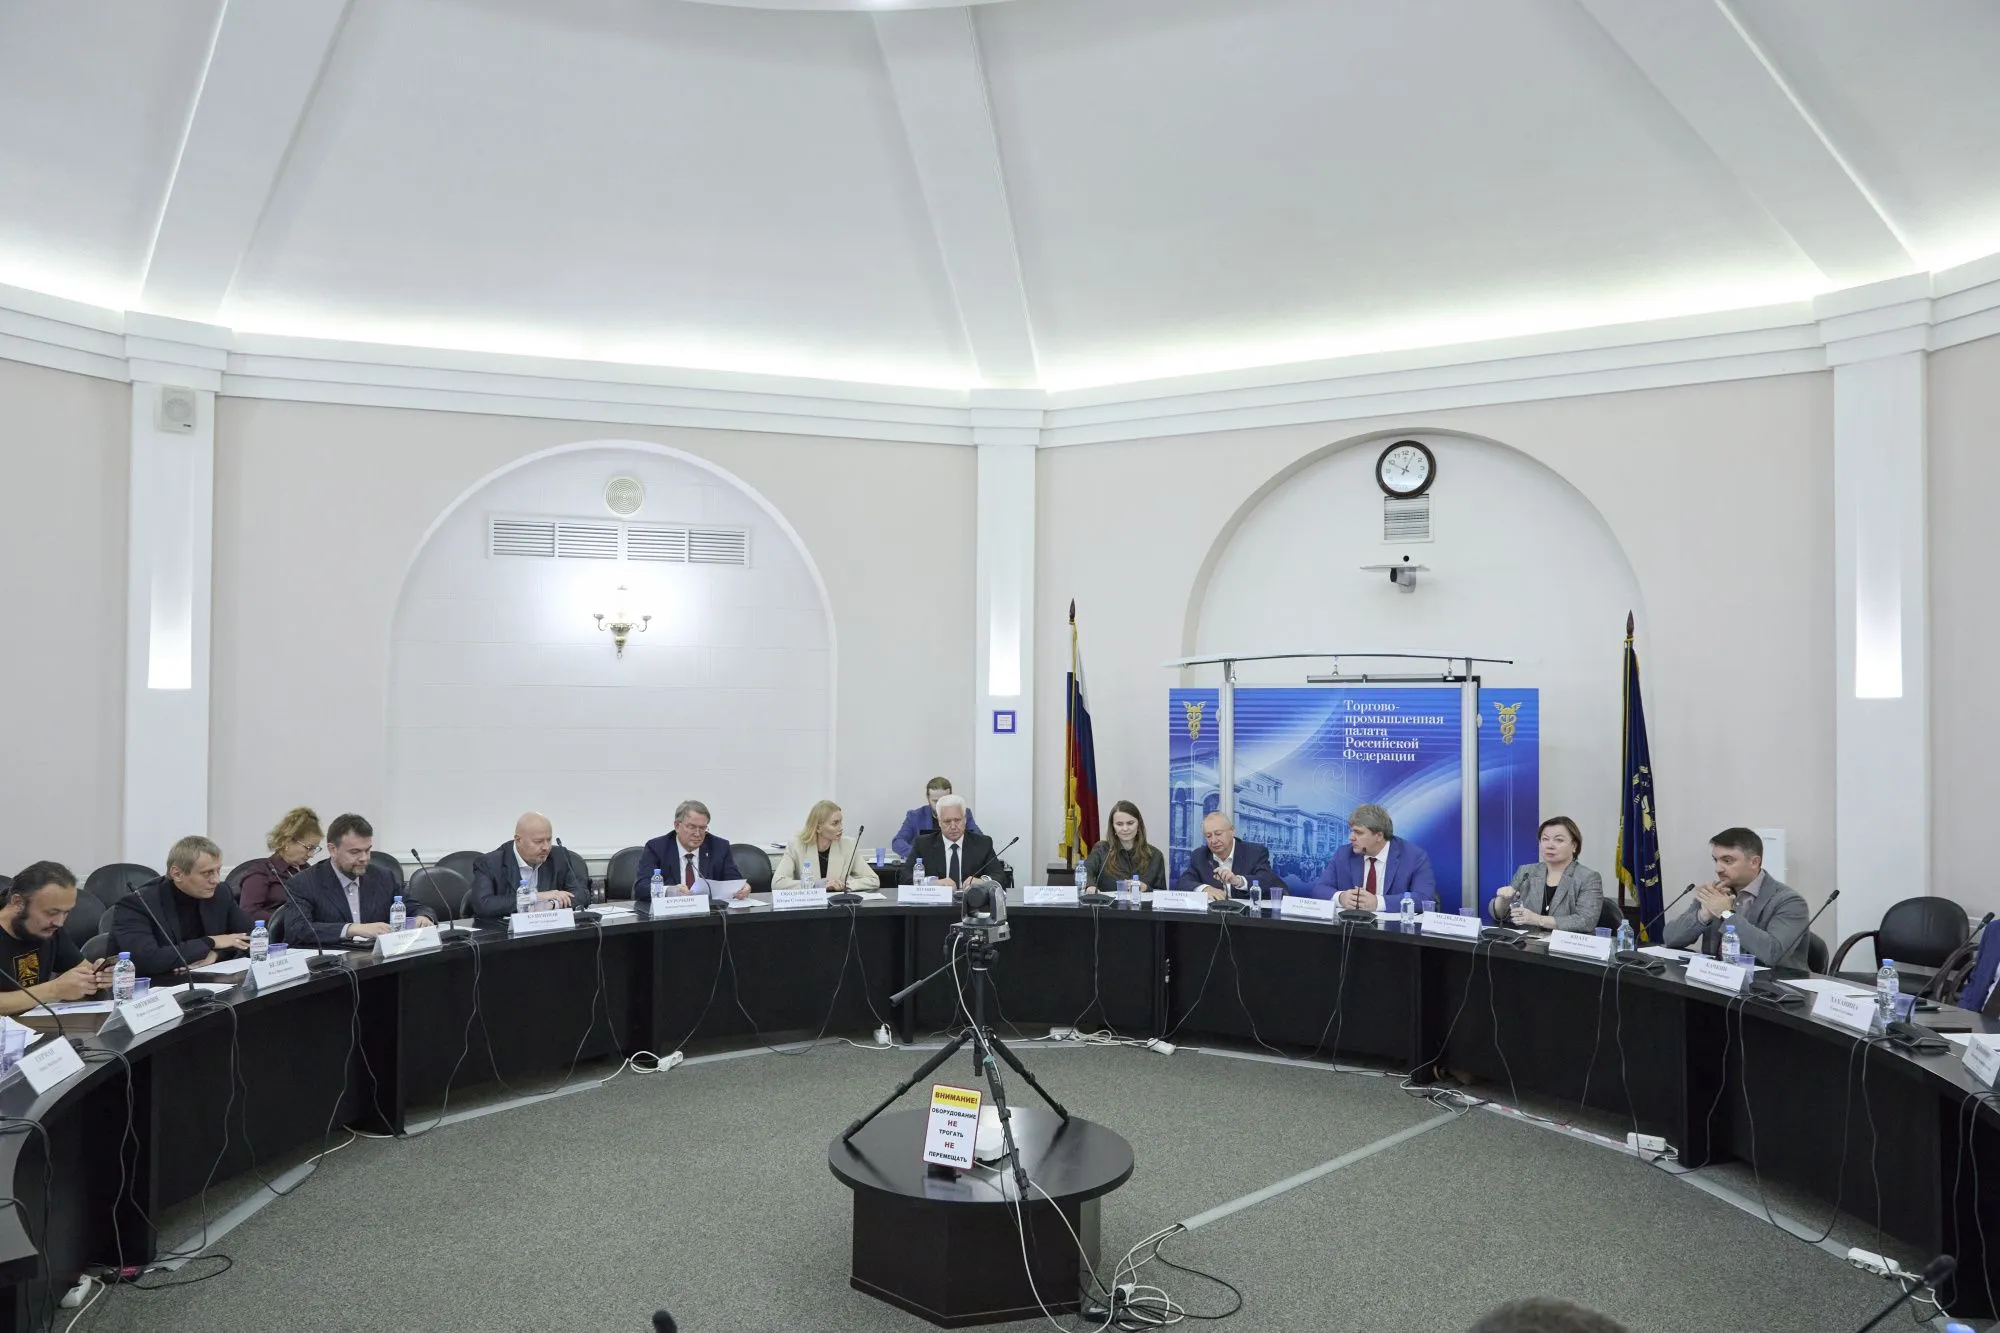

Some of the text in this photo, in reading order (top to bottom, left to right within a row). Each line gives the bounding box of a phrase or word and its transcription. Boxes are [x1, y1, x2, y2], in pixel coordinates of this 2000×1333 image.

[1343, 699, 1400, 714] Торгово-
[1344, 715, 1444, 726] промышленная
[1344, 727, 1388, 736] палата
[1345, 736, 1419, 749] Российской
[1343, 748, 1416, 763] Федерации
[935, 1091, 978, 1104] ВНИМАНИЕ!
[931, 1107, 977, 1119] ОБОРУДОВАНИЕ
[947, 1120, 958, 1128] НЕ
[939, 1129, 964, 1138] ТРОГАТЬ
[928, 1151, 967, 1163] ПЕРЕМЕЩАТЬ
